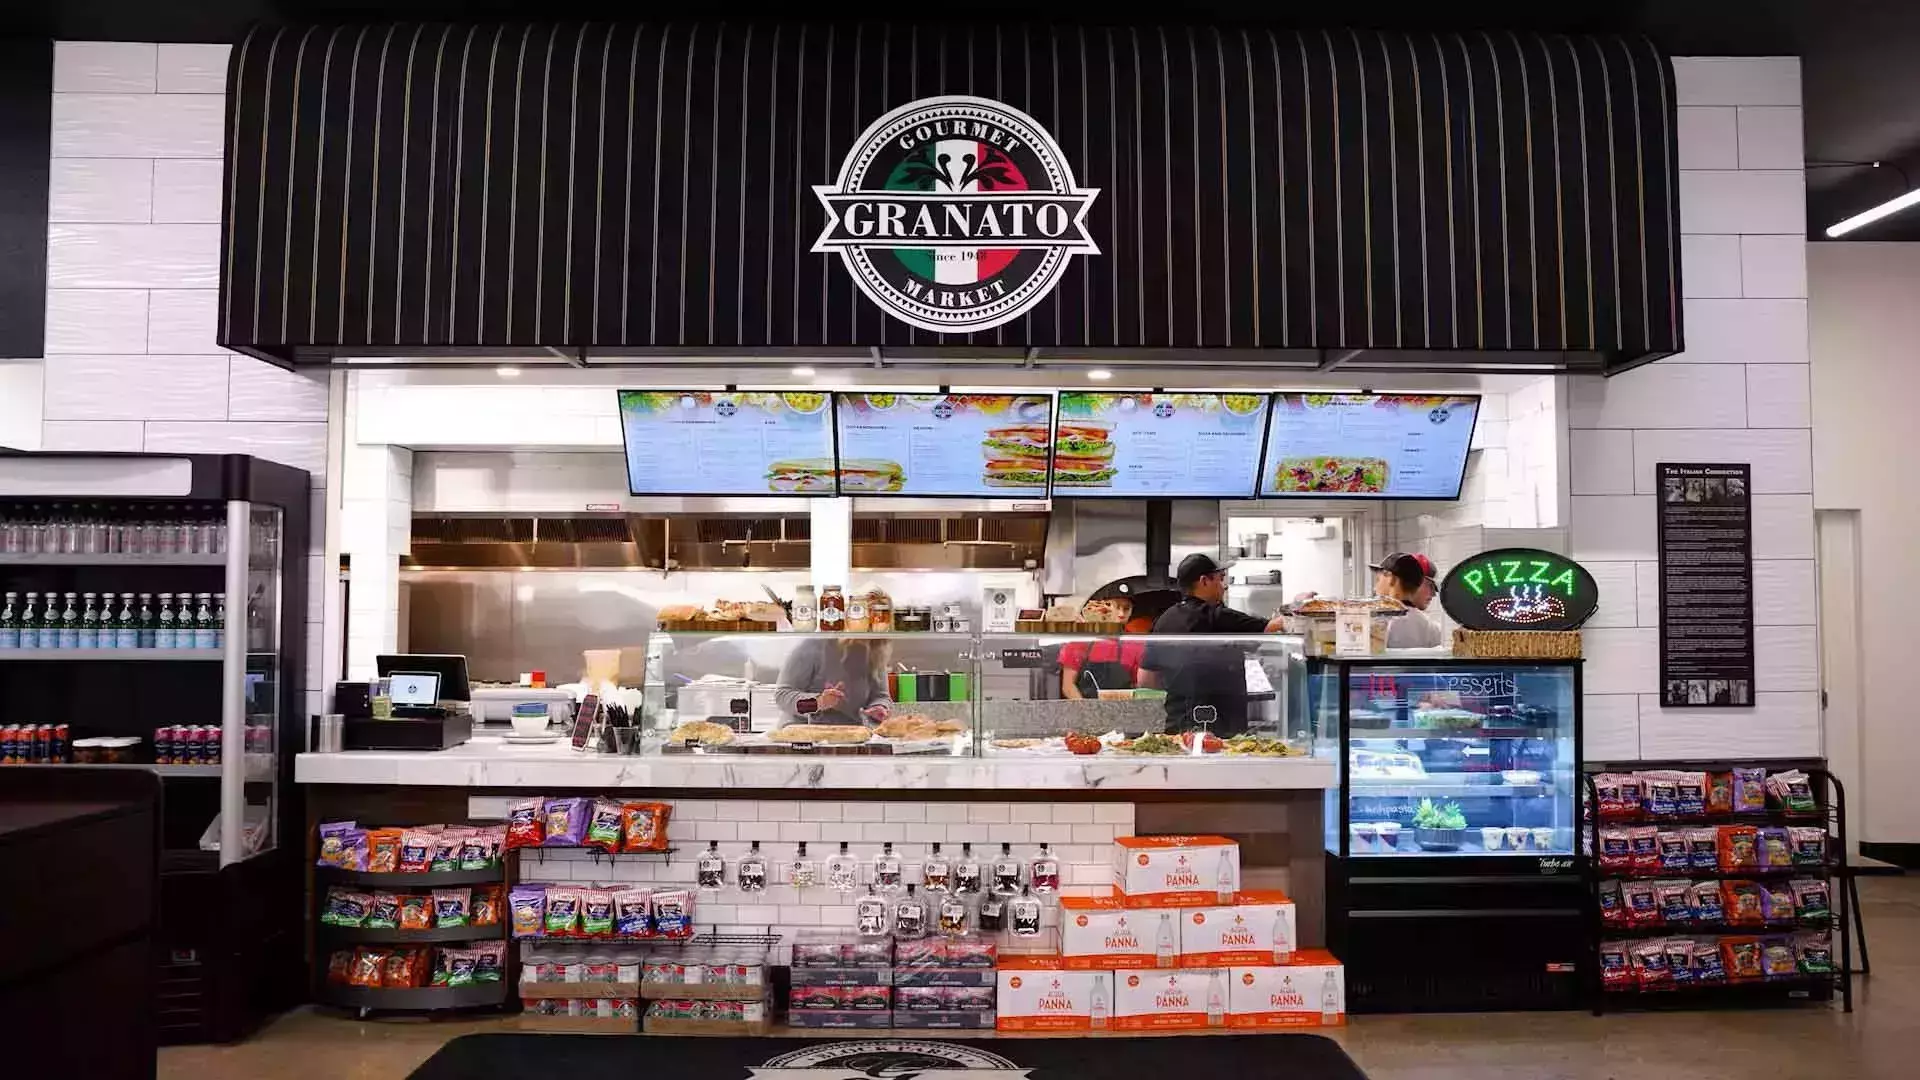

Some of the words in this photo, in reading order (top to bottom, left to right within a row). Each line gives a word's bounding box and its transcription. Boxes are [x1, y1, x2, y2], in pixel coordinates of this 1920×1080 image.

[899, 121, 1020, 151] GOURMET
[844, 203, 1069, 238] GRANATO
[902, 278, 1006, 307] MARKET
[1463, 560, 1575, 596] PIZZA
[1166, 874, 1200, 887] PANNA
[1105, 936, 1139, 949] PANNA
[1222, 933, 1256, 945] PANNA
[1039, 998, 1073, 1010] PANNA
[1156, 995, 1190, 1008] PANNA
[1271, 994, 1304, 1006] PANNA
